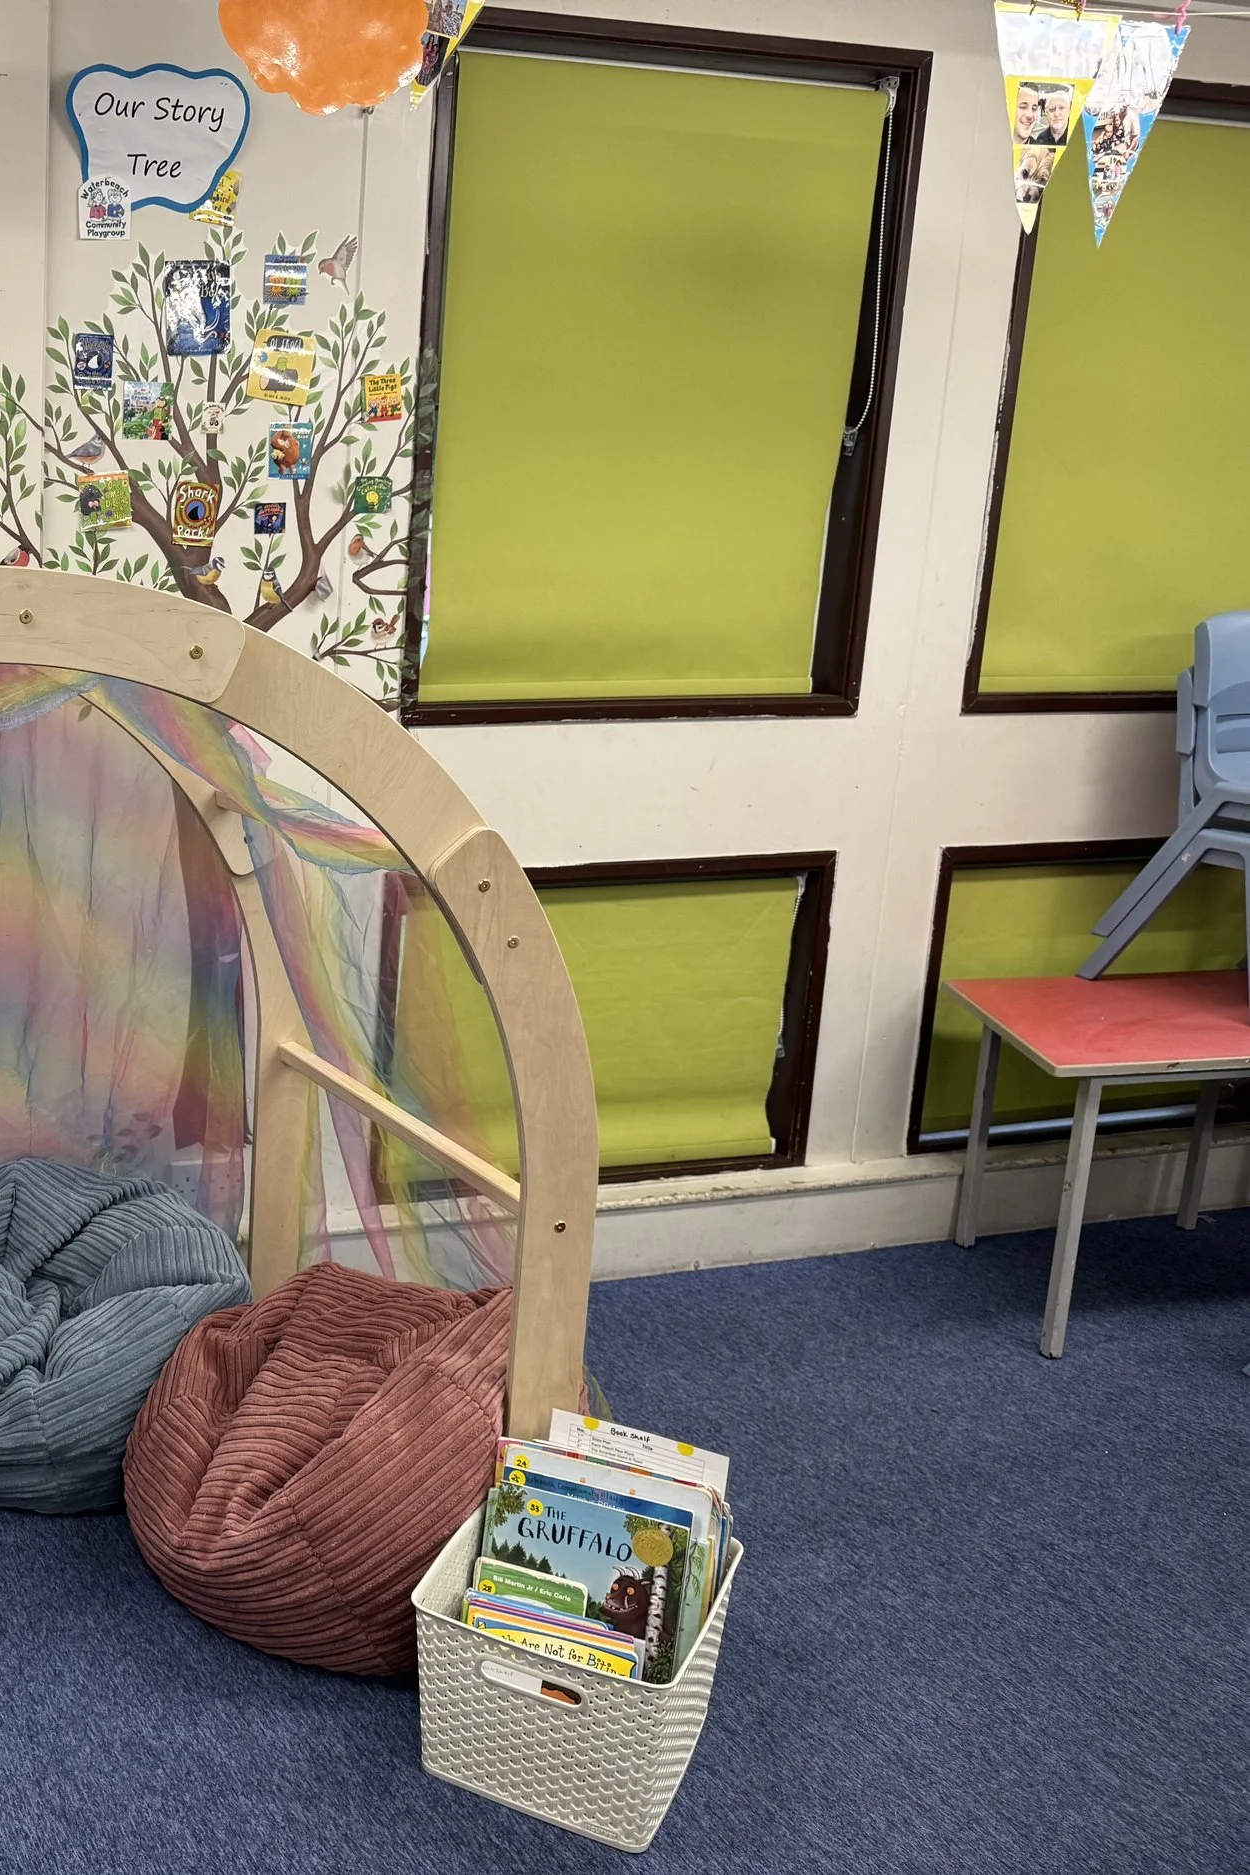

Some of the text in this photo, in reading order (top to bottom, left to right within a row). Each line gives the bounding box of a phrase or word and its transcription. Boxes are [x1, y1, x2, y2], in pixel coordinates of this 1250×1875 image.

[94, 92, 225, 132] Our Story
[127, 153, 182, 178] Tree
[80, 178, 129, 200] Waterbeach
[85, 220, 127, 230] Community
[87, 229, 126, 239] Playgroup
[180, 484, 215, 504] Shark
[177, 525, 210, 537] Park!
[610, 1427, 628, 1438] Book
[516, 1459, 527, 1468] 24
[544, 1506, 567, 1521] THE
[517, 1517, 632, 1562] GRUFFALO
[482, 1584, 492, 1592] 28
[493, 1574, 504, 1583] Bill
[504, 1578, 526, 1589] Martin
[526, 1584, 534, 1592] Jr
[539, 1587, 553, 1597] Eric
[553, 1591, 571, 1602] Carle
[521, 1638, 540, 1651] Are
[544, 1643, 565, 1659] Not
[568, 1650, 584, 1663] for
[586, 1652, 628, 1678] Bitin
